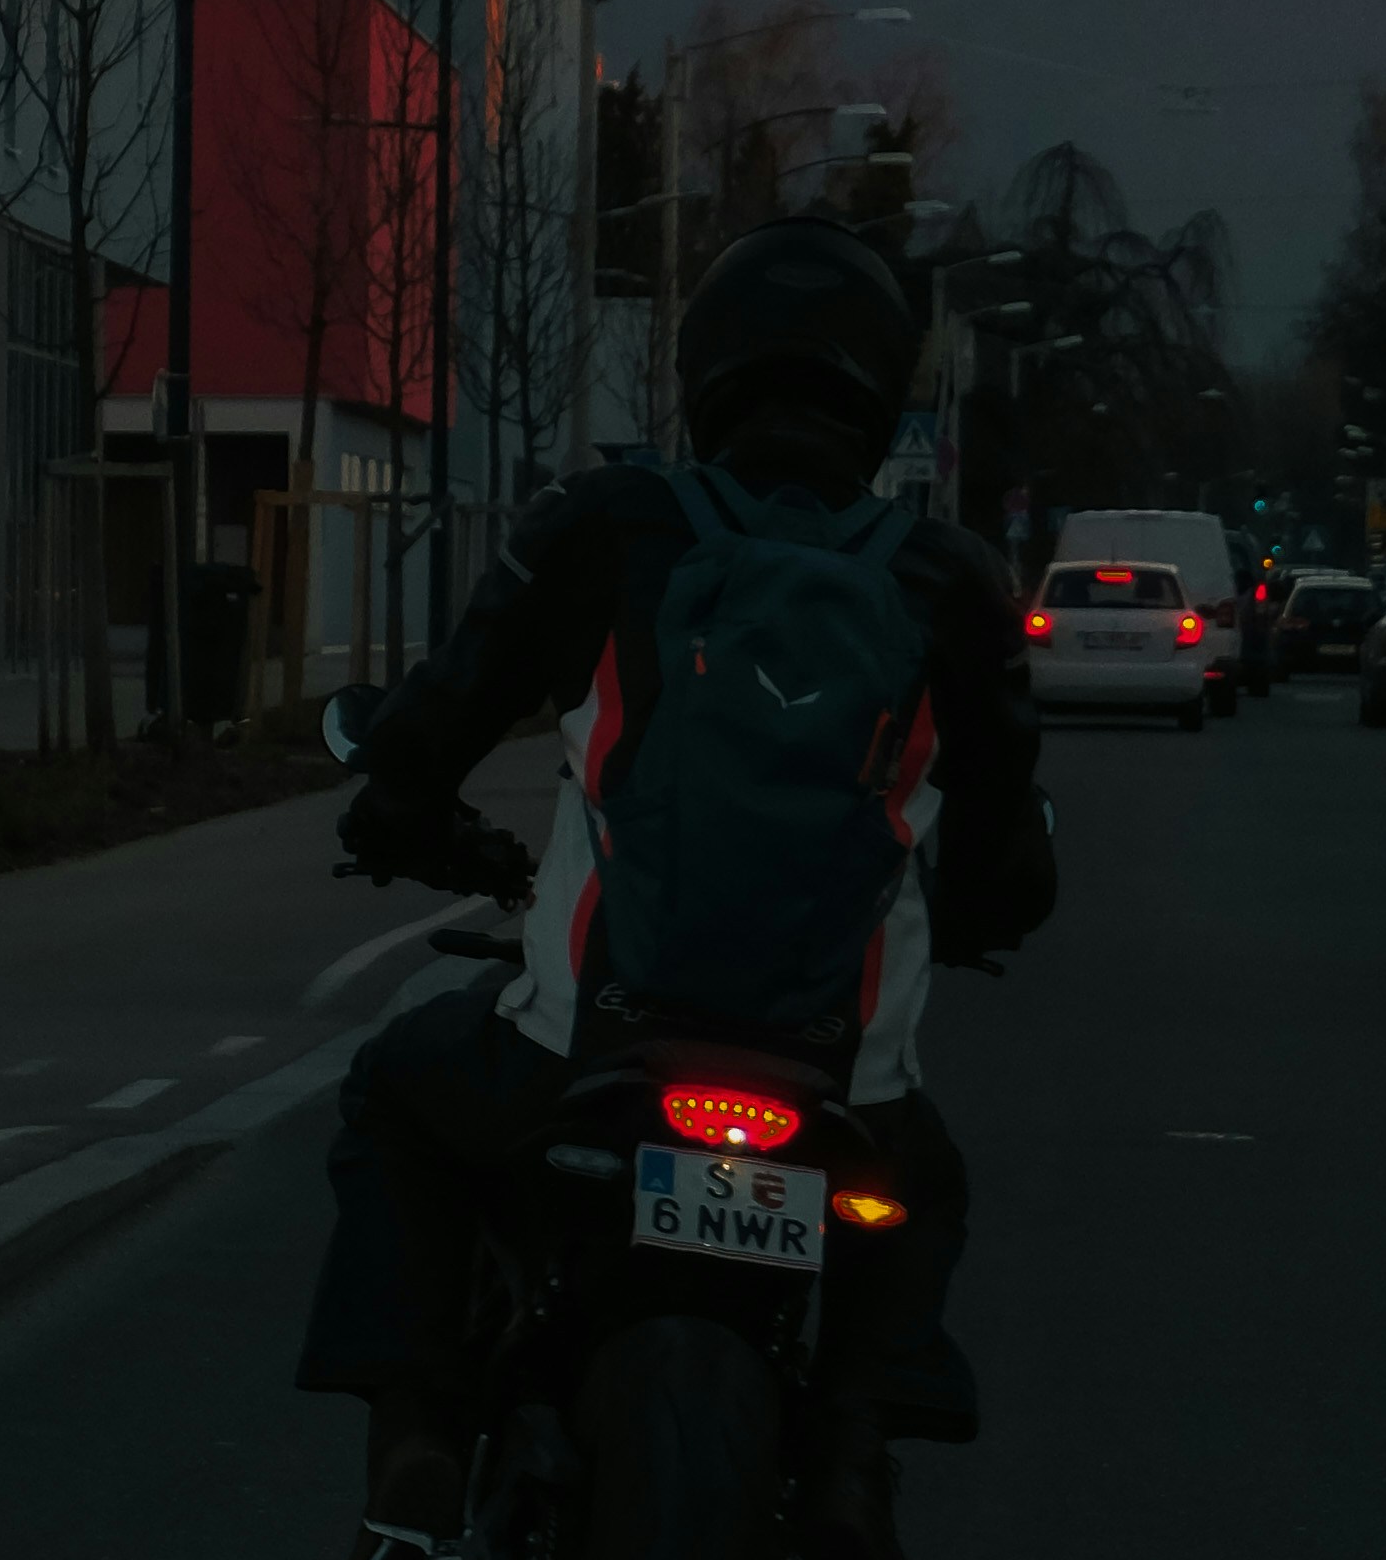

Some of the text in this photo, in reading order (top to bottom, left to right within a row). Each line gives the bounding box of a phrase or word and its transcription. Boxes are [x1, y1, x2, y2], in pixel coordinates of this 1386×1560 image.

[706, 1161, 735, 1200] S
[653, 1197, 807, 1256] 6 NWR
